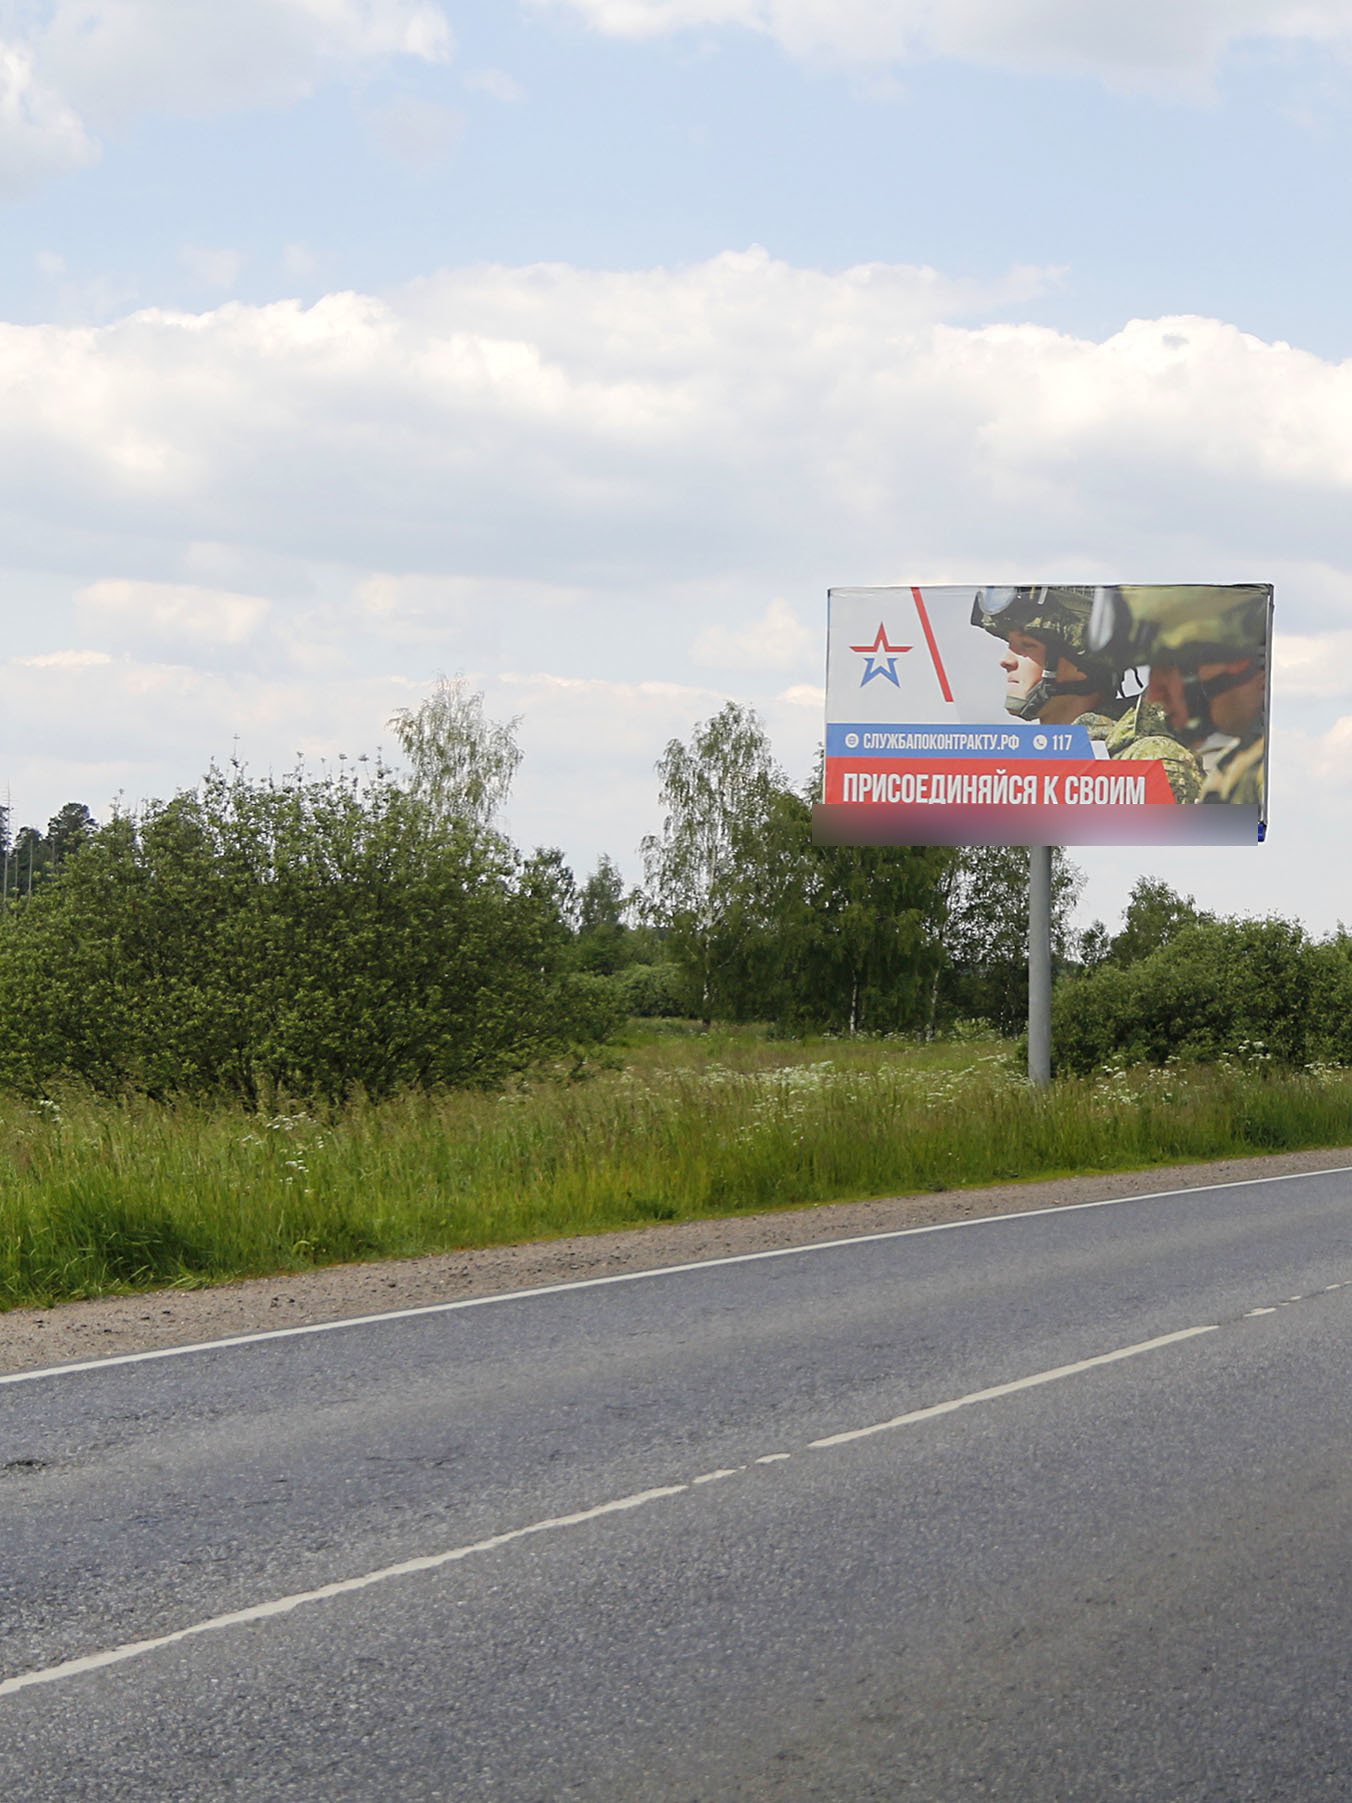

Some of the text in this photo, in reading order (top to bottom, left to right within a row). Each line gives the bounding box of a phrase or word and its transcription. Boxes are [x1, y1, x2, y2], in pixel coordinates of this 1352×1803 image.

[863, 733, 1020, 750] СЛУЖБАПОКОНТРАКТУ.РФ
[1052, 734, 1073, 751] 117
[843, 768, 1146, 804] ПРИСОЕДИНЯЙСЯ К СВОИМ
